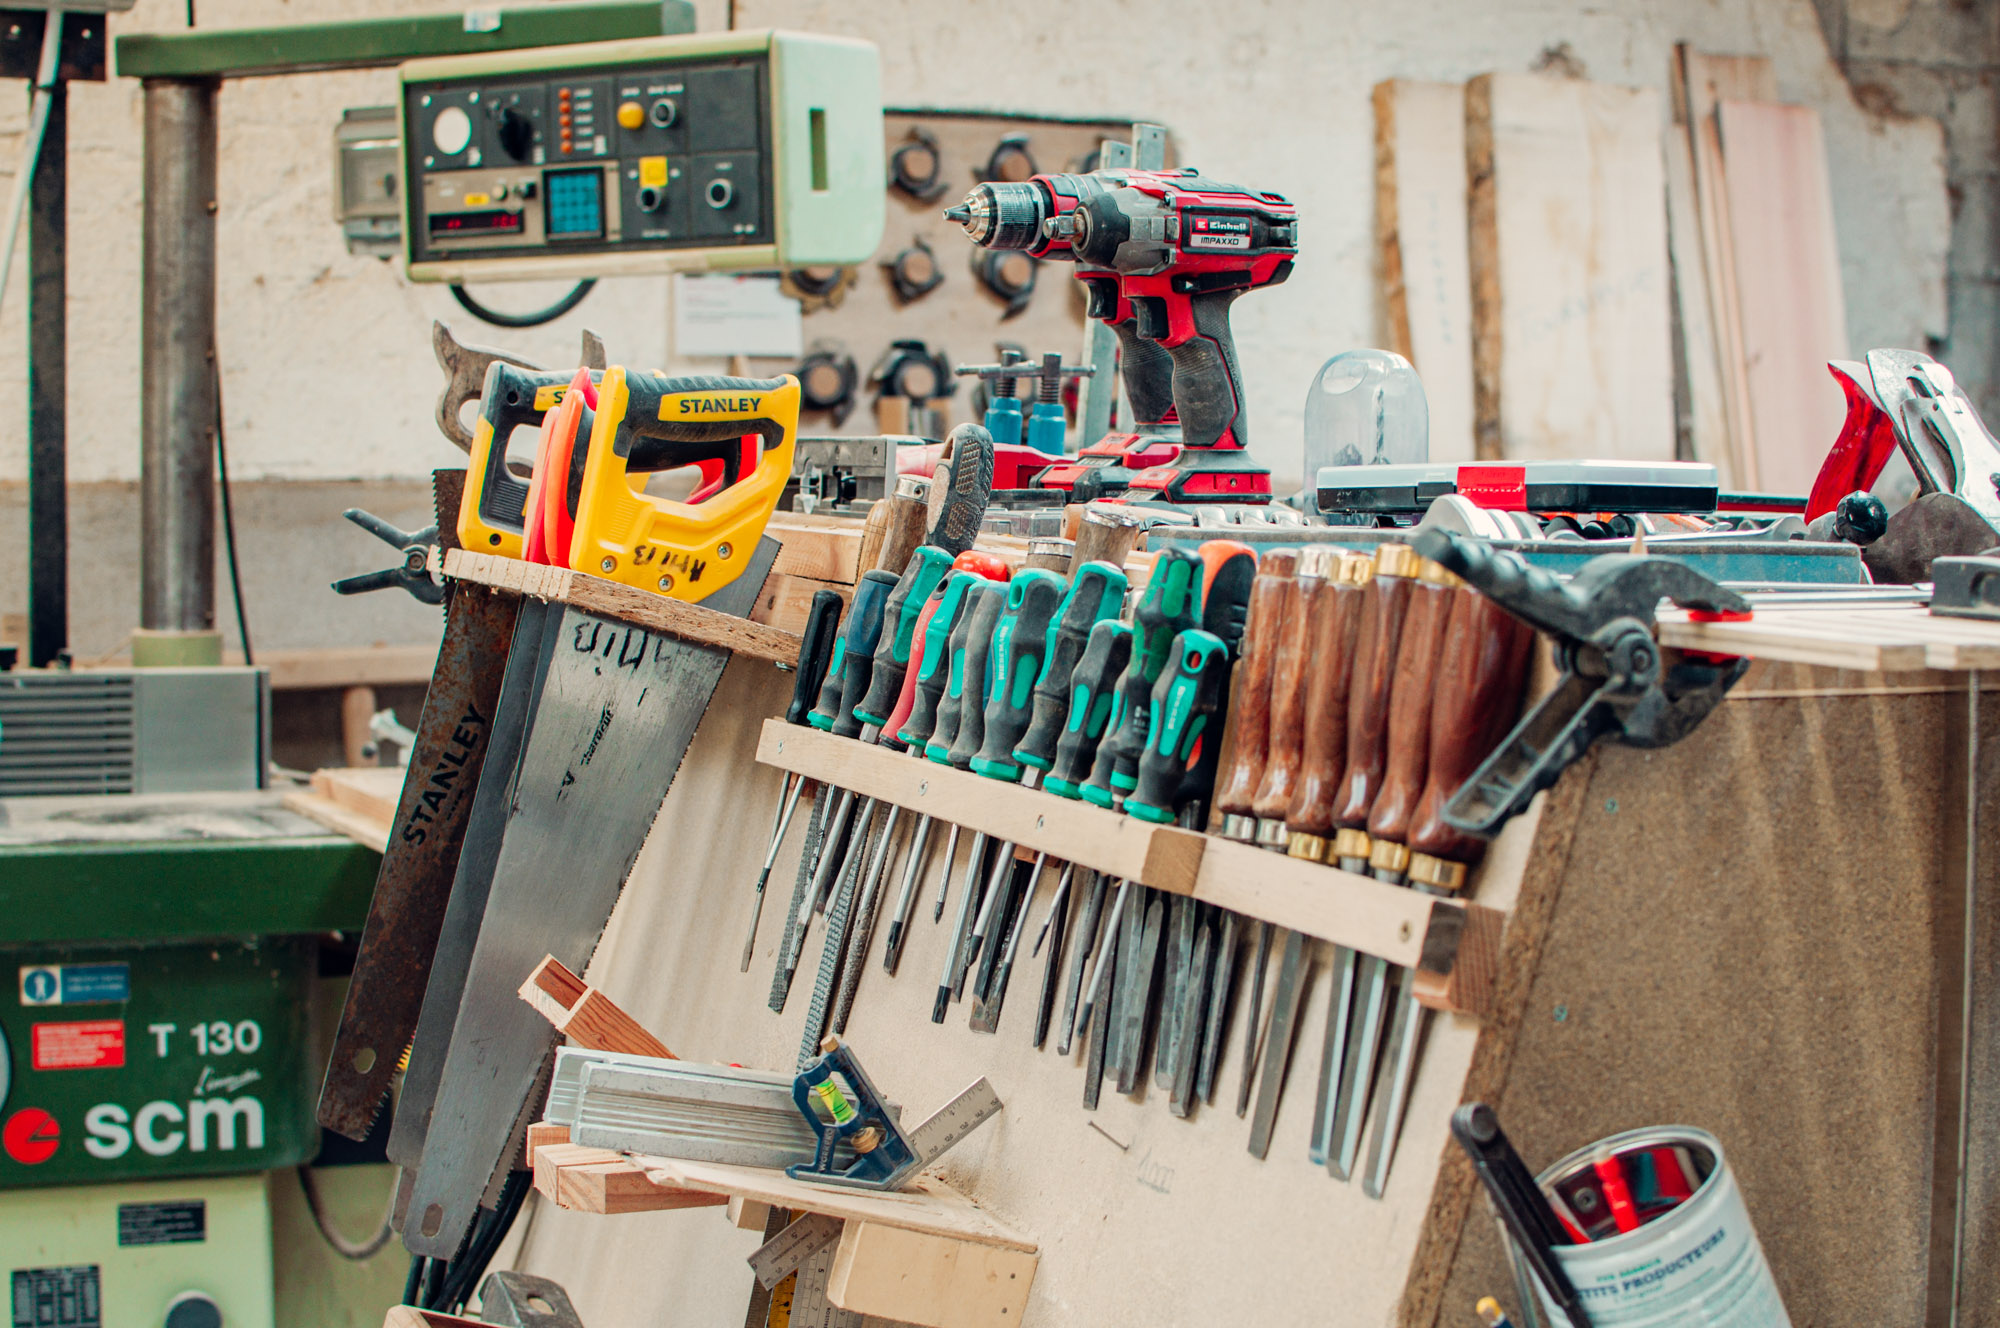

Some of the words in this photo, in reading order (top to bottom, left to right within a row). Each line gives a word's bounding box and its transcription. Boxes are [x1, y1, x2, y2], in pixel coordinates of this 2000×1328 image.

[1200, 236, 1240, 245] IMPAXXO
[1209, 221, 1247, 231] Einhell
[679, 397, 762, 415] STANLEY
[402, 703, 486, 845] STANLEY
[148, 1024, 177, 1057] T
[190, 1020, 262, 1056] 130
[84, 1095, 265, 1159] scm
[1623, 1226, 1726, 1292] PRODUCTEURS
